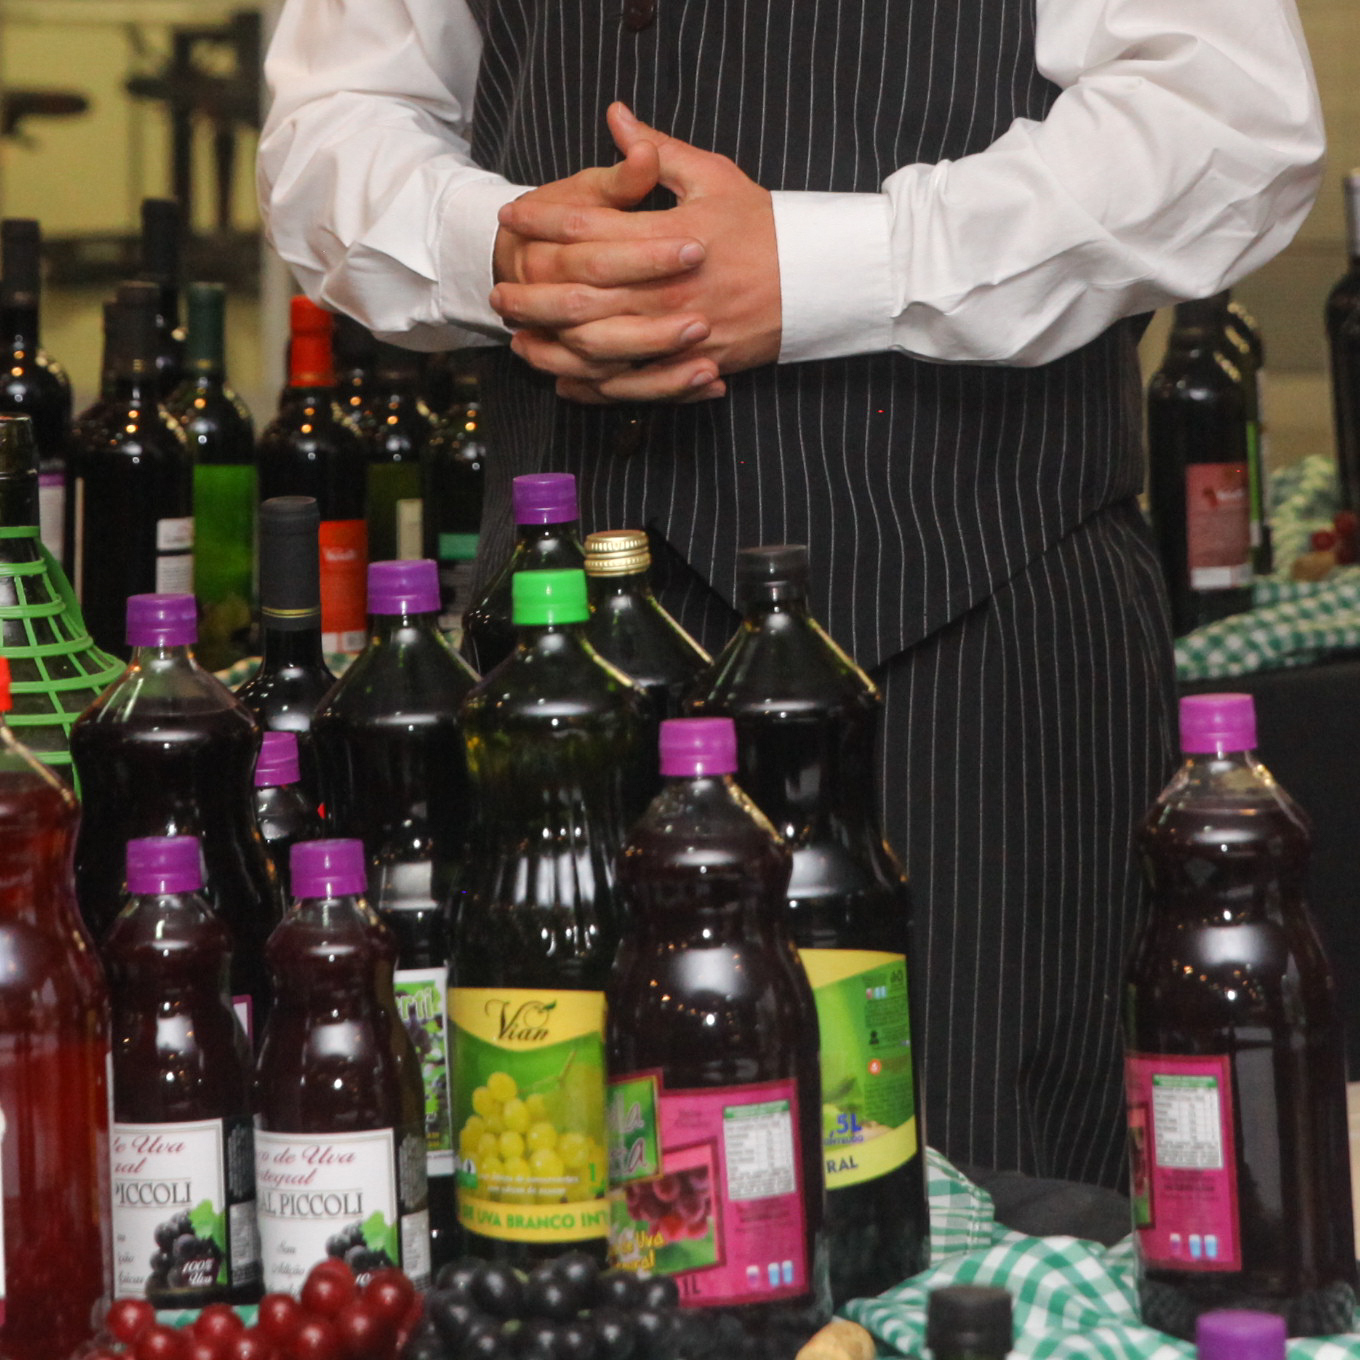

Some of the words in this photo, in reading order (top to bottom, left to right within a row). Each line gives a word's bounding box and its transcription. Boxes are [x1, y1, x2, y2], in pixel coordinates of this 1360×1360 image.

[131, 1134, 185, 1155] Uva
[273, 1147, 296, 1165] de
[301, 1144, 356, 1166] Uva
[279, 1191, 364, 1217] PICCOLI
[478, 1210, 502, 1227] UVA
[507, 1213, 576, 1230] BRANCO
